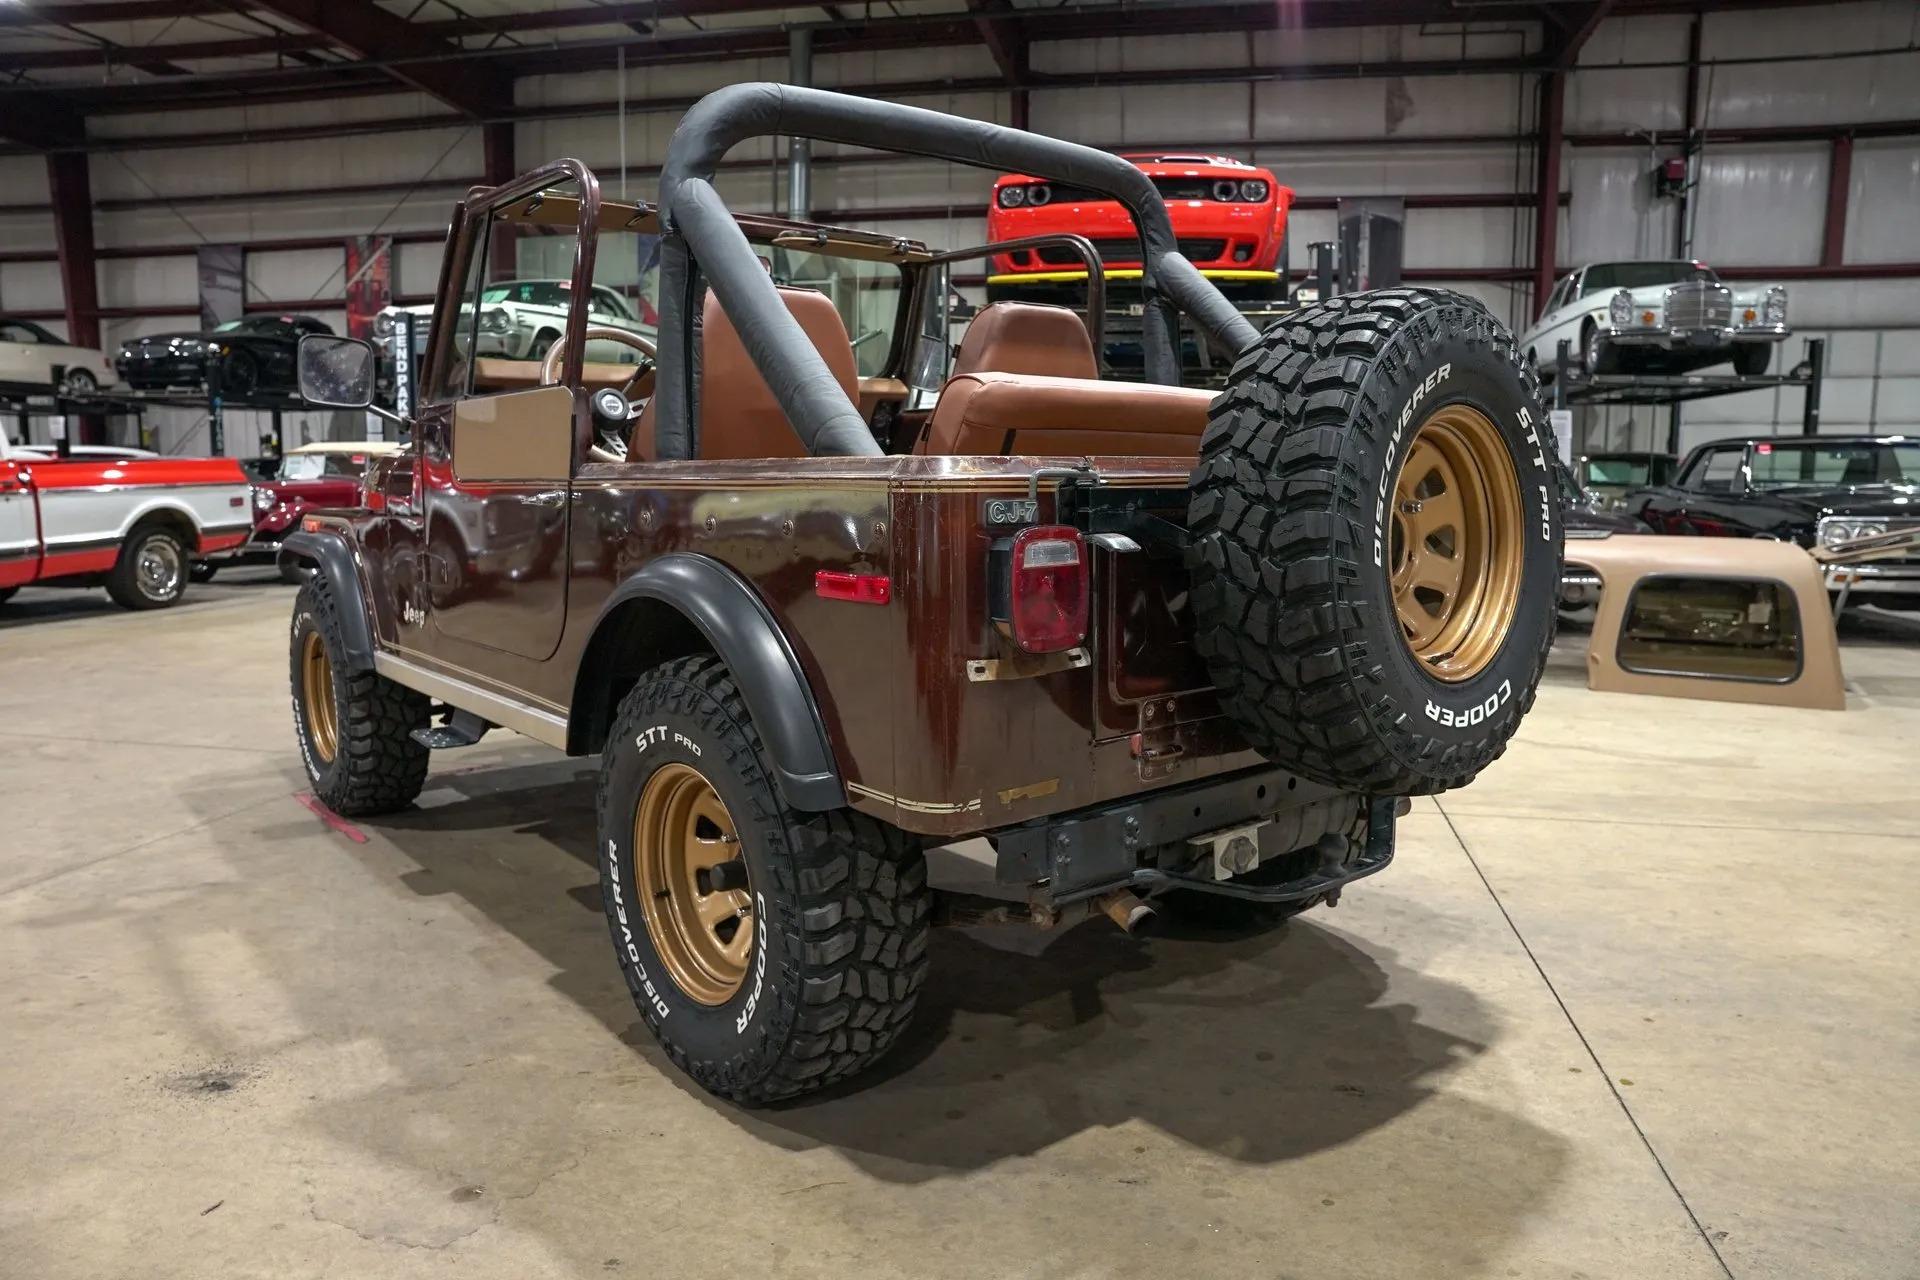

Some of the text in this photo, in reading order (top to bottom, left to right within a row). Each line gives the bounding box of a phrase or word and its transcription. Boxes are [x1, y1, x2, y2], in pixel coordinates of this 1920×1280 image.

[1374, 362, 1451, 567] DISCOVERER
[1516, 406, 1550, 541] STT PRO
[403, 600, 425, 629] Jeep
[636, 725, 702, 757] STT PRO
[1425, 679, 1512, 728] COOPER
[608, 839, 670, 1019] DISCOVERER
[736, 891, 767, 1034] COOPER
